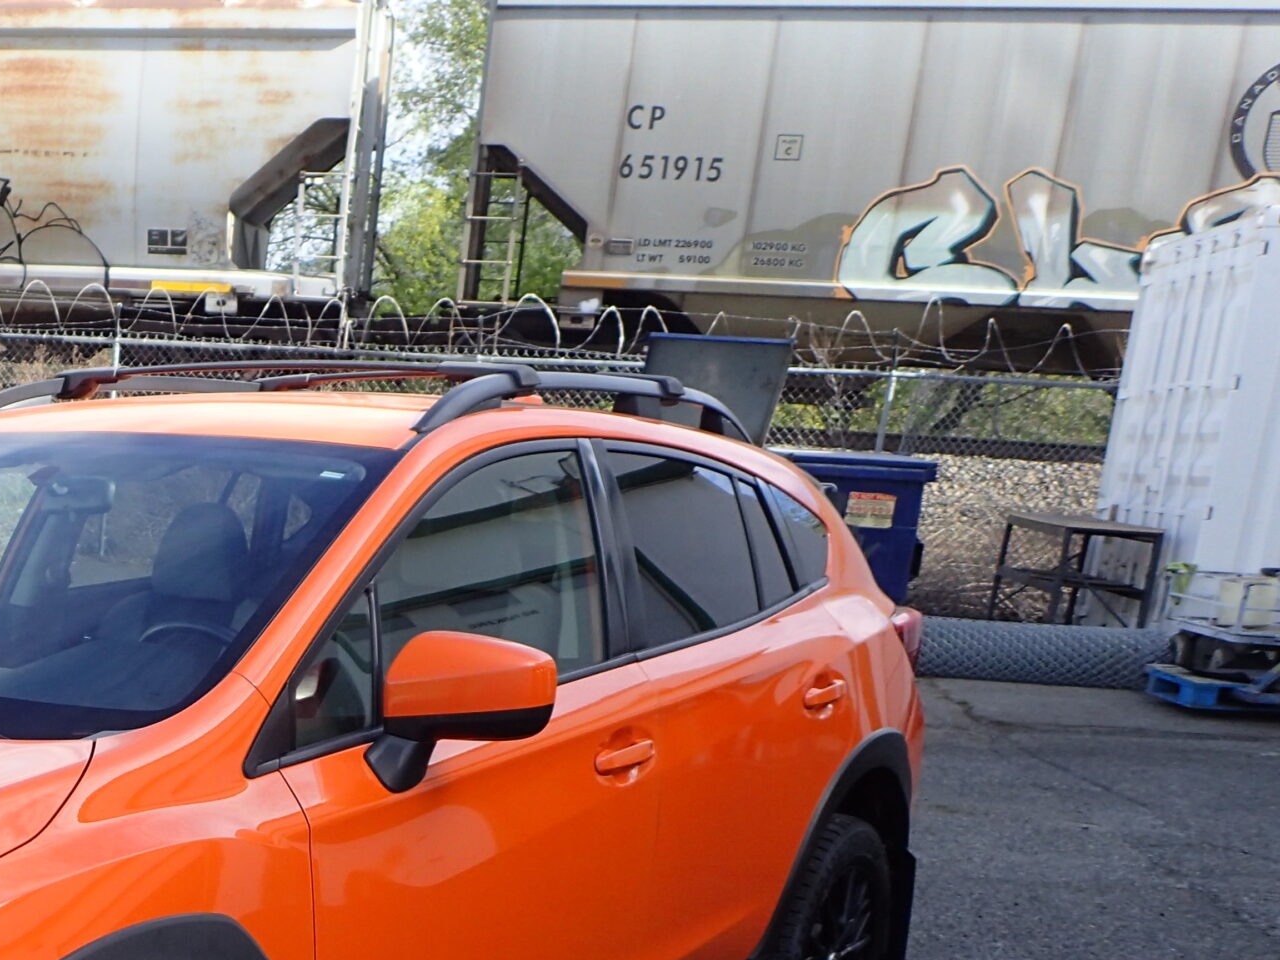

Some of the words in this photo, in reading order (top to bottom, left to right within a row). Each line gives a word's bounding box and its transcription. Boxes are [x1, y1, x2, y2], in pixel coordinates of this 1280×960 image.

[627, 104, 666, 130] CP
[619, 154, 724, 182] 651915
[653, 239, 672, 247] LMT
[674, 240, 713, 248] 226900
[647, 254, 664, 263] WT
[678, 254, 711, 264] 59100
